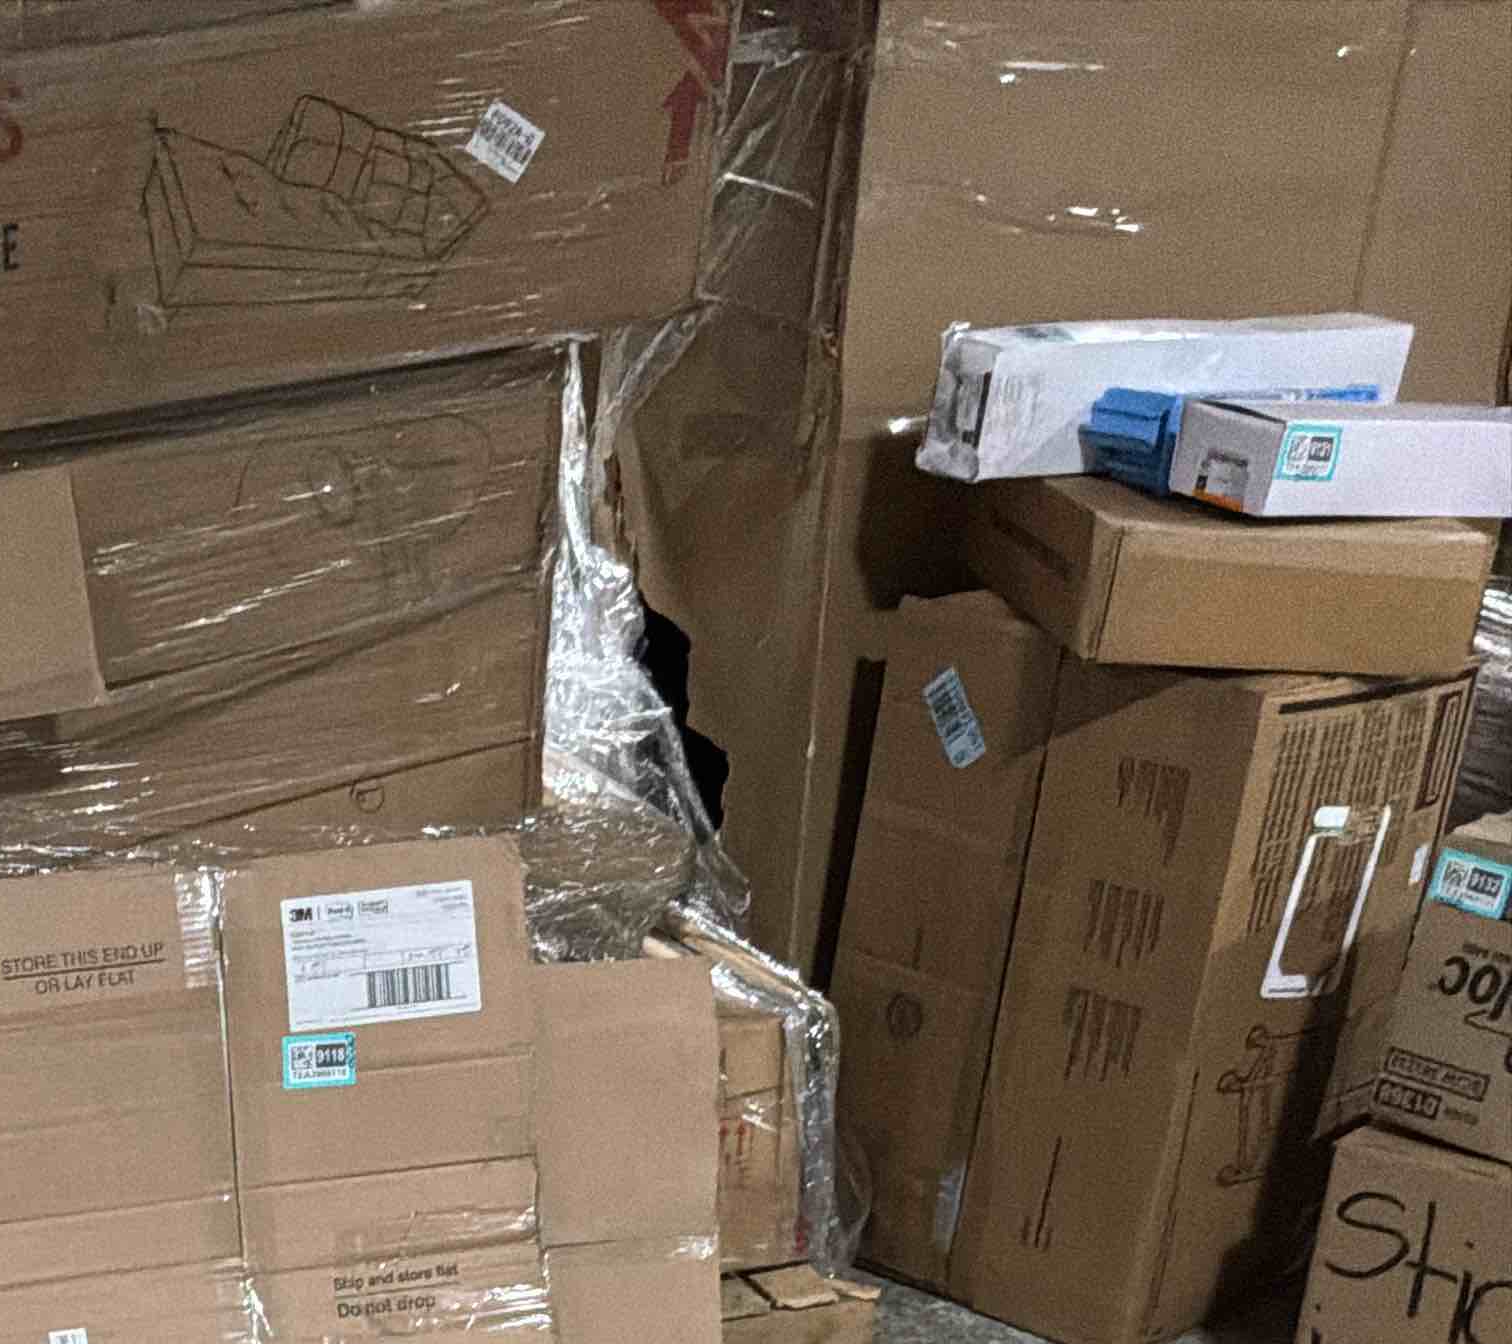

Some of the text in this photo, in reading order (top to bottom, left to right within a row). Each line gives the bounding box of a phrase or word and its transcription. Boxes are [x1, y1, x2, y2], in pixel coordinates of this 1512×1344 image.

[0, 941, 165, 976] STORE THIS END UP
[34, 969, 138, 996] OR LAY FLAT
[316, 1047, 347, 1064] 9118
[333, 1263, 460, 1292] Ship and store flat
[336, 1292, 437, 1319] Do not drop
